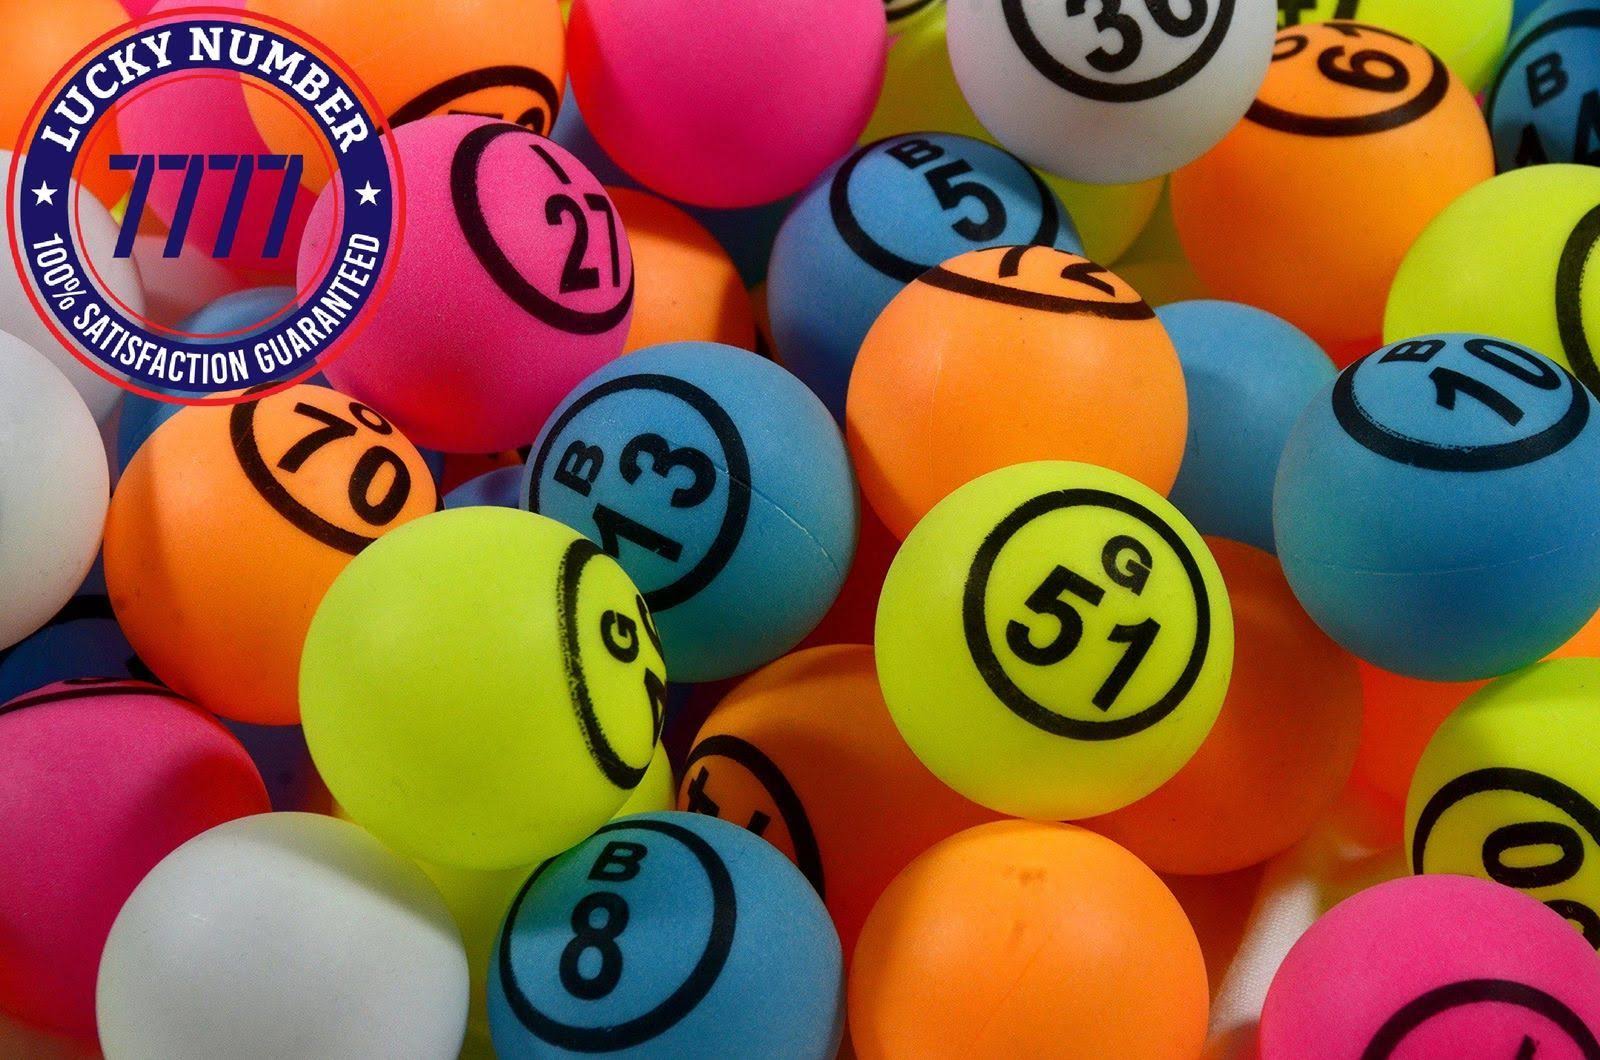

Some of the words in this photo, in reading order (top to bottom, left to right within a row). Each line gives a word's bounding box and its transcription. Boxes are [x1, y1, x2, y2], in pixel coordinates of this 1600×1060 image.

[1526, 51, 1569, 109] B
[884, 139, 945, 170] B
[924, 158, 1007, 242] 5
[544, 193, 621, 294] 27
[1377, 339, 1447, 364] B
[1428, 338, 1562, 427] 10
[348, 401, 393, 435] O
[276, 402, 411, 527] 70
[553, 440, 604, 497] B
[592, 433, 717, 563] 13
[1101, 534, 1153, 597] G
[600, 609, 639, 663] G
[1005, 563, 1162, 713] 51
[587, 841, 648, 882] B
[559, 891, 630, 1000] 8
